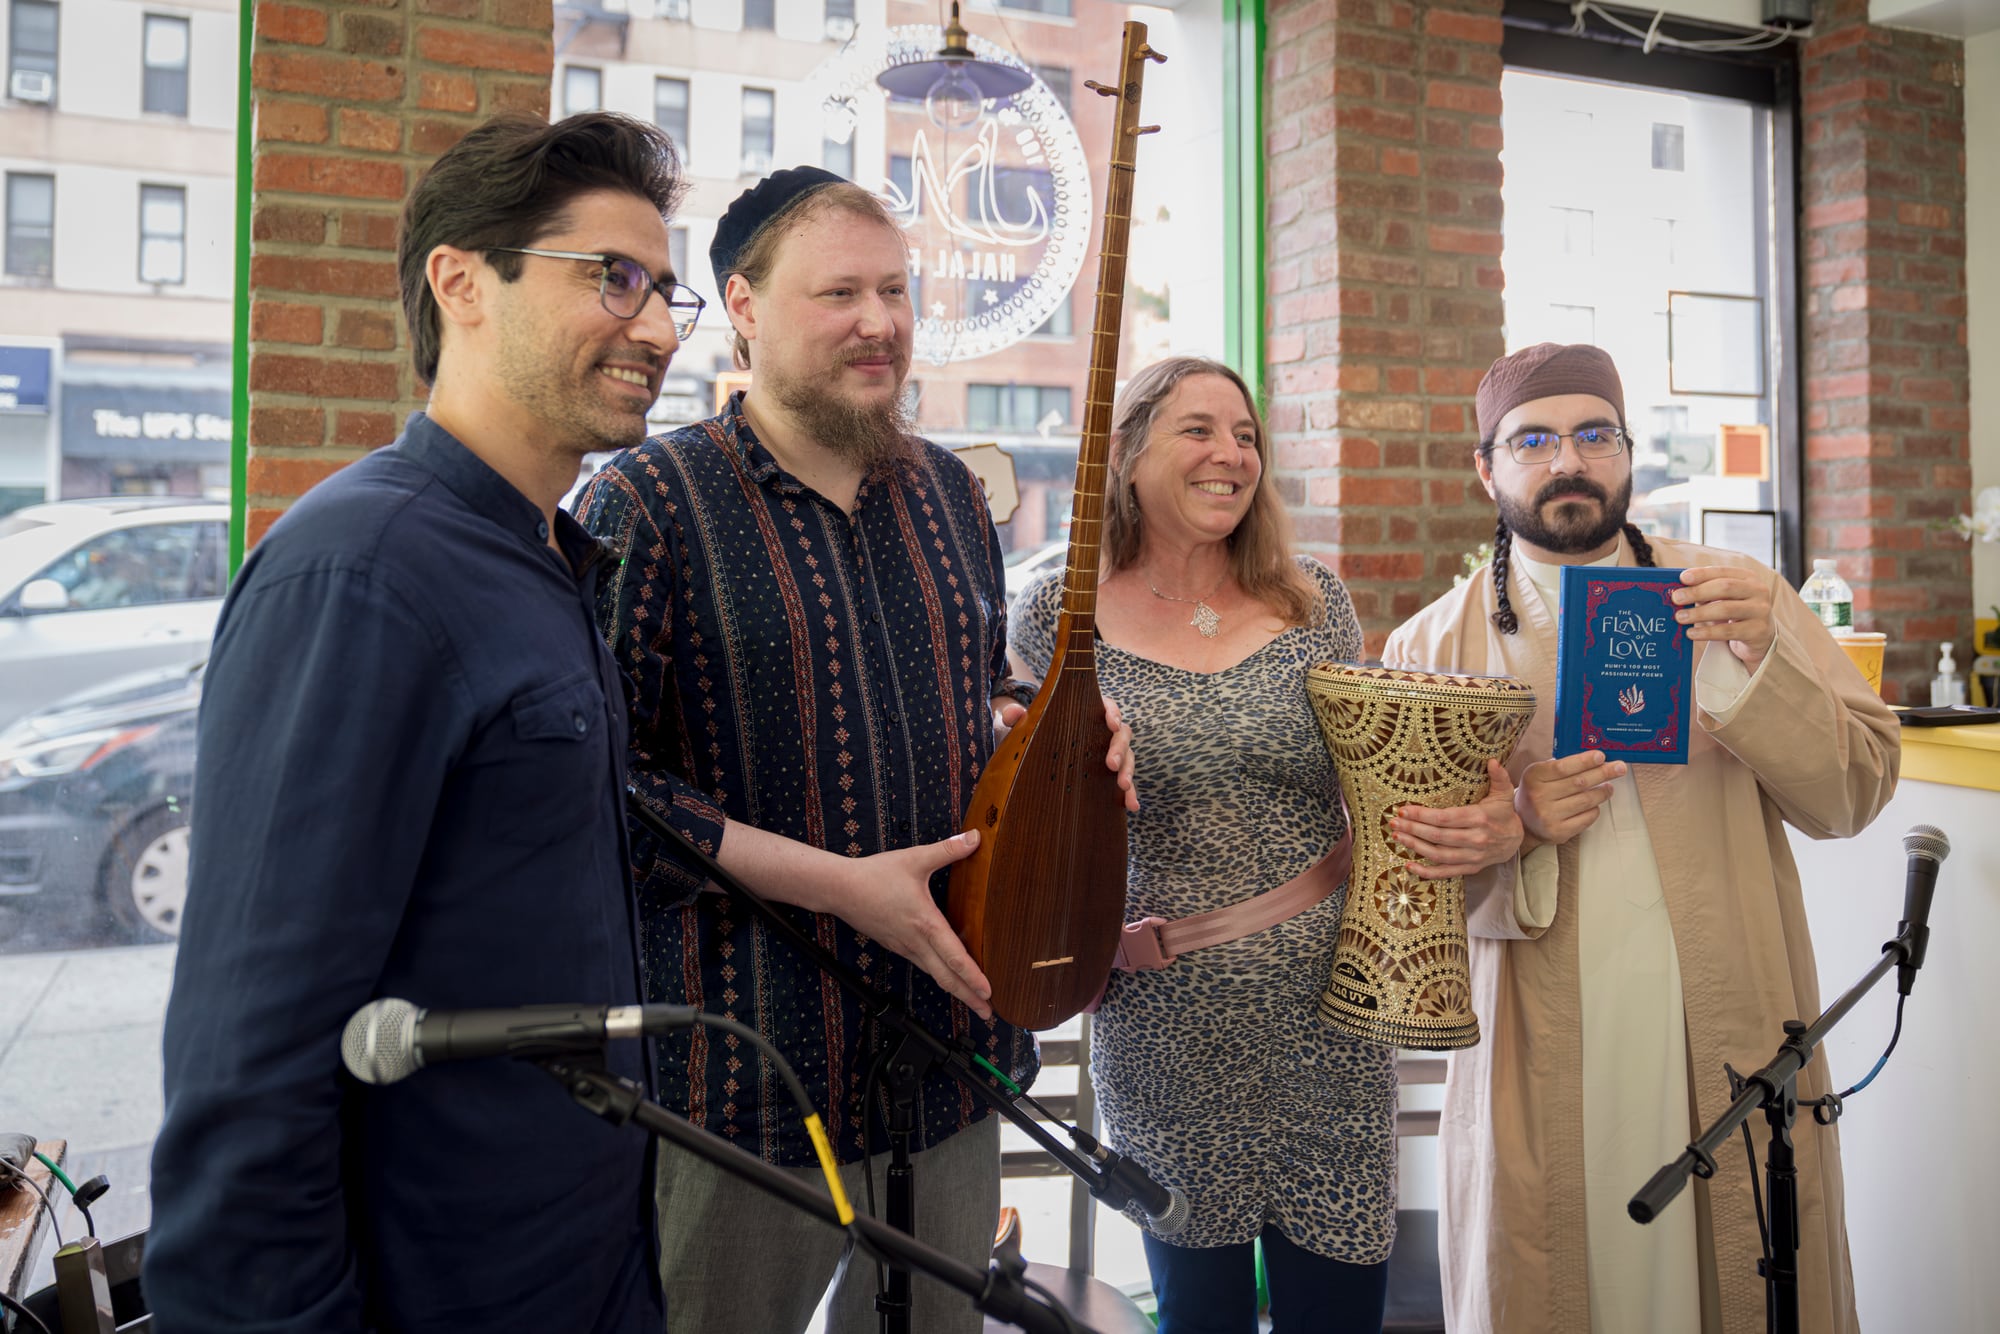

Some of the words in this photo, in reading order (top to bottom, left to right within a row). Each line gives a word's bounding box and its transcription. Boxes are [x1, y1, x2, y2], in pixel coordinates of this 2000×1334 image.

[93, 409, 141, 438] The
[1602, 613, 1666, 636] FLAME
[1609, 637, 1657, 659] LOVE
